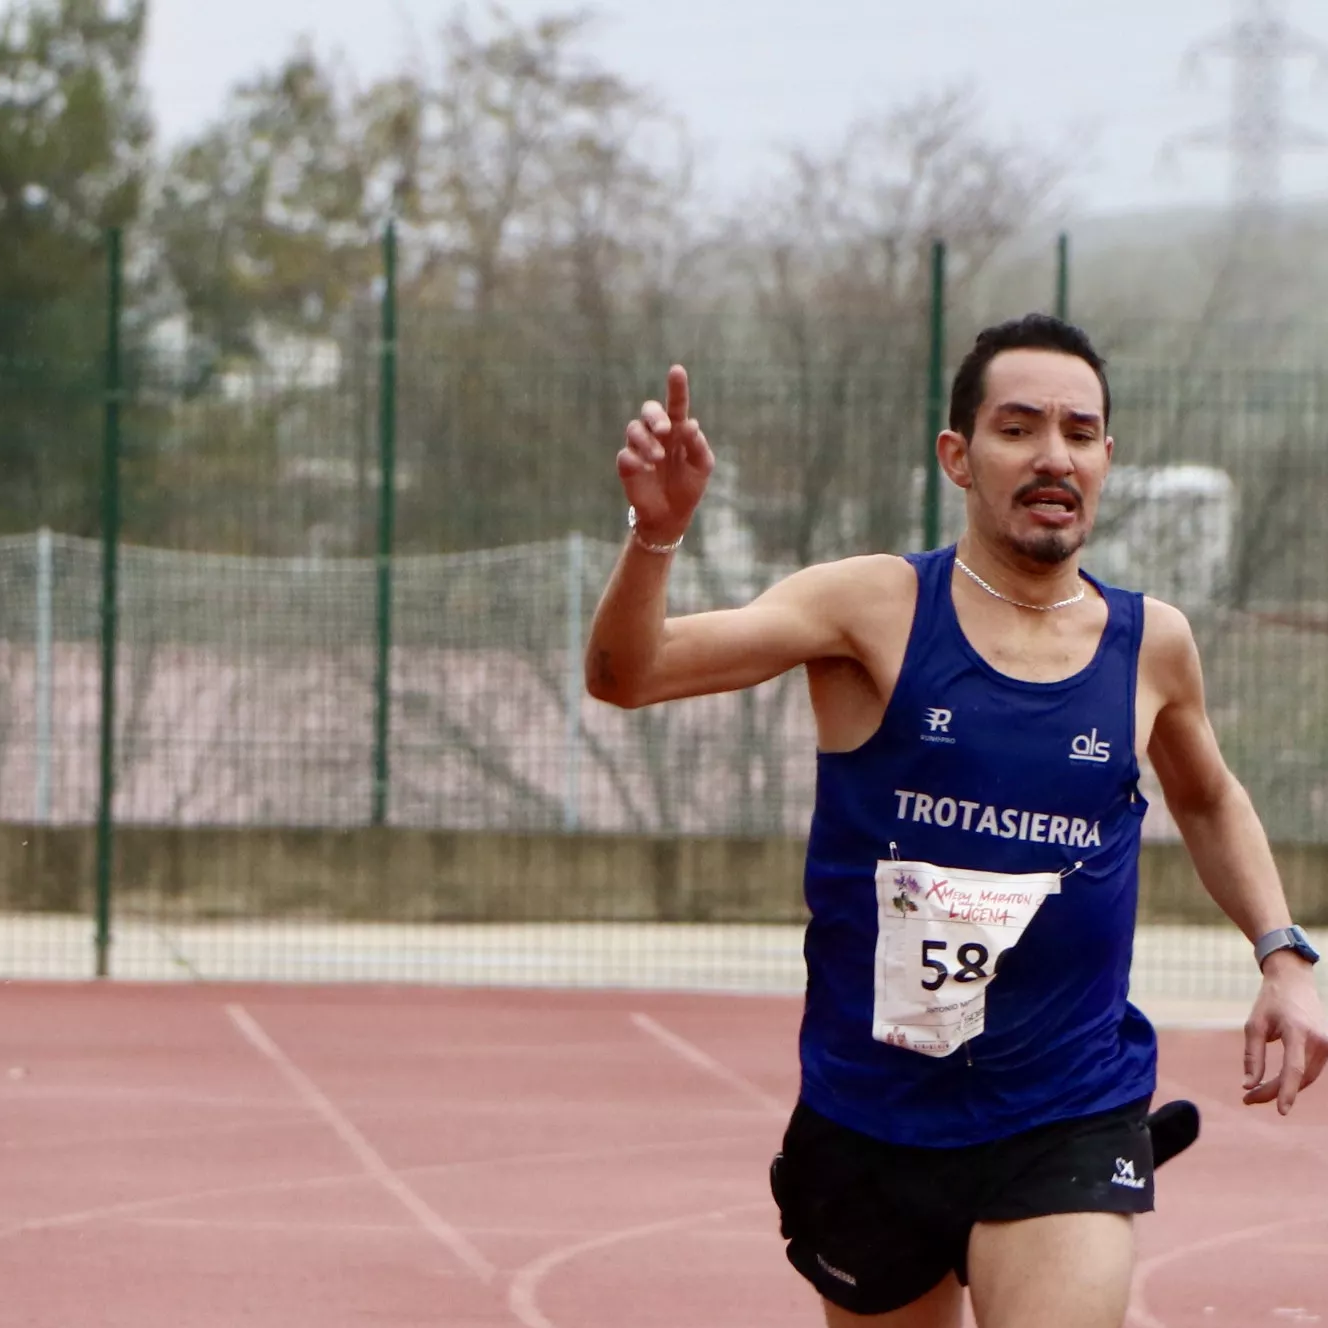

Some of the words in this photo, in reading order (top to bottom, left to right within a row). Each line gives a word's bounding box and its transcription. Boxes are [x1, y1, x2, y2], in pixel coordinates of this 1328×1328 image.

[894, 789, 1102, 848] TROTASIERRA
[948, 902, 1017, 925] LUCENA
[921, 940, 1014, 991] 58
